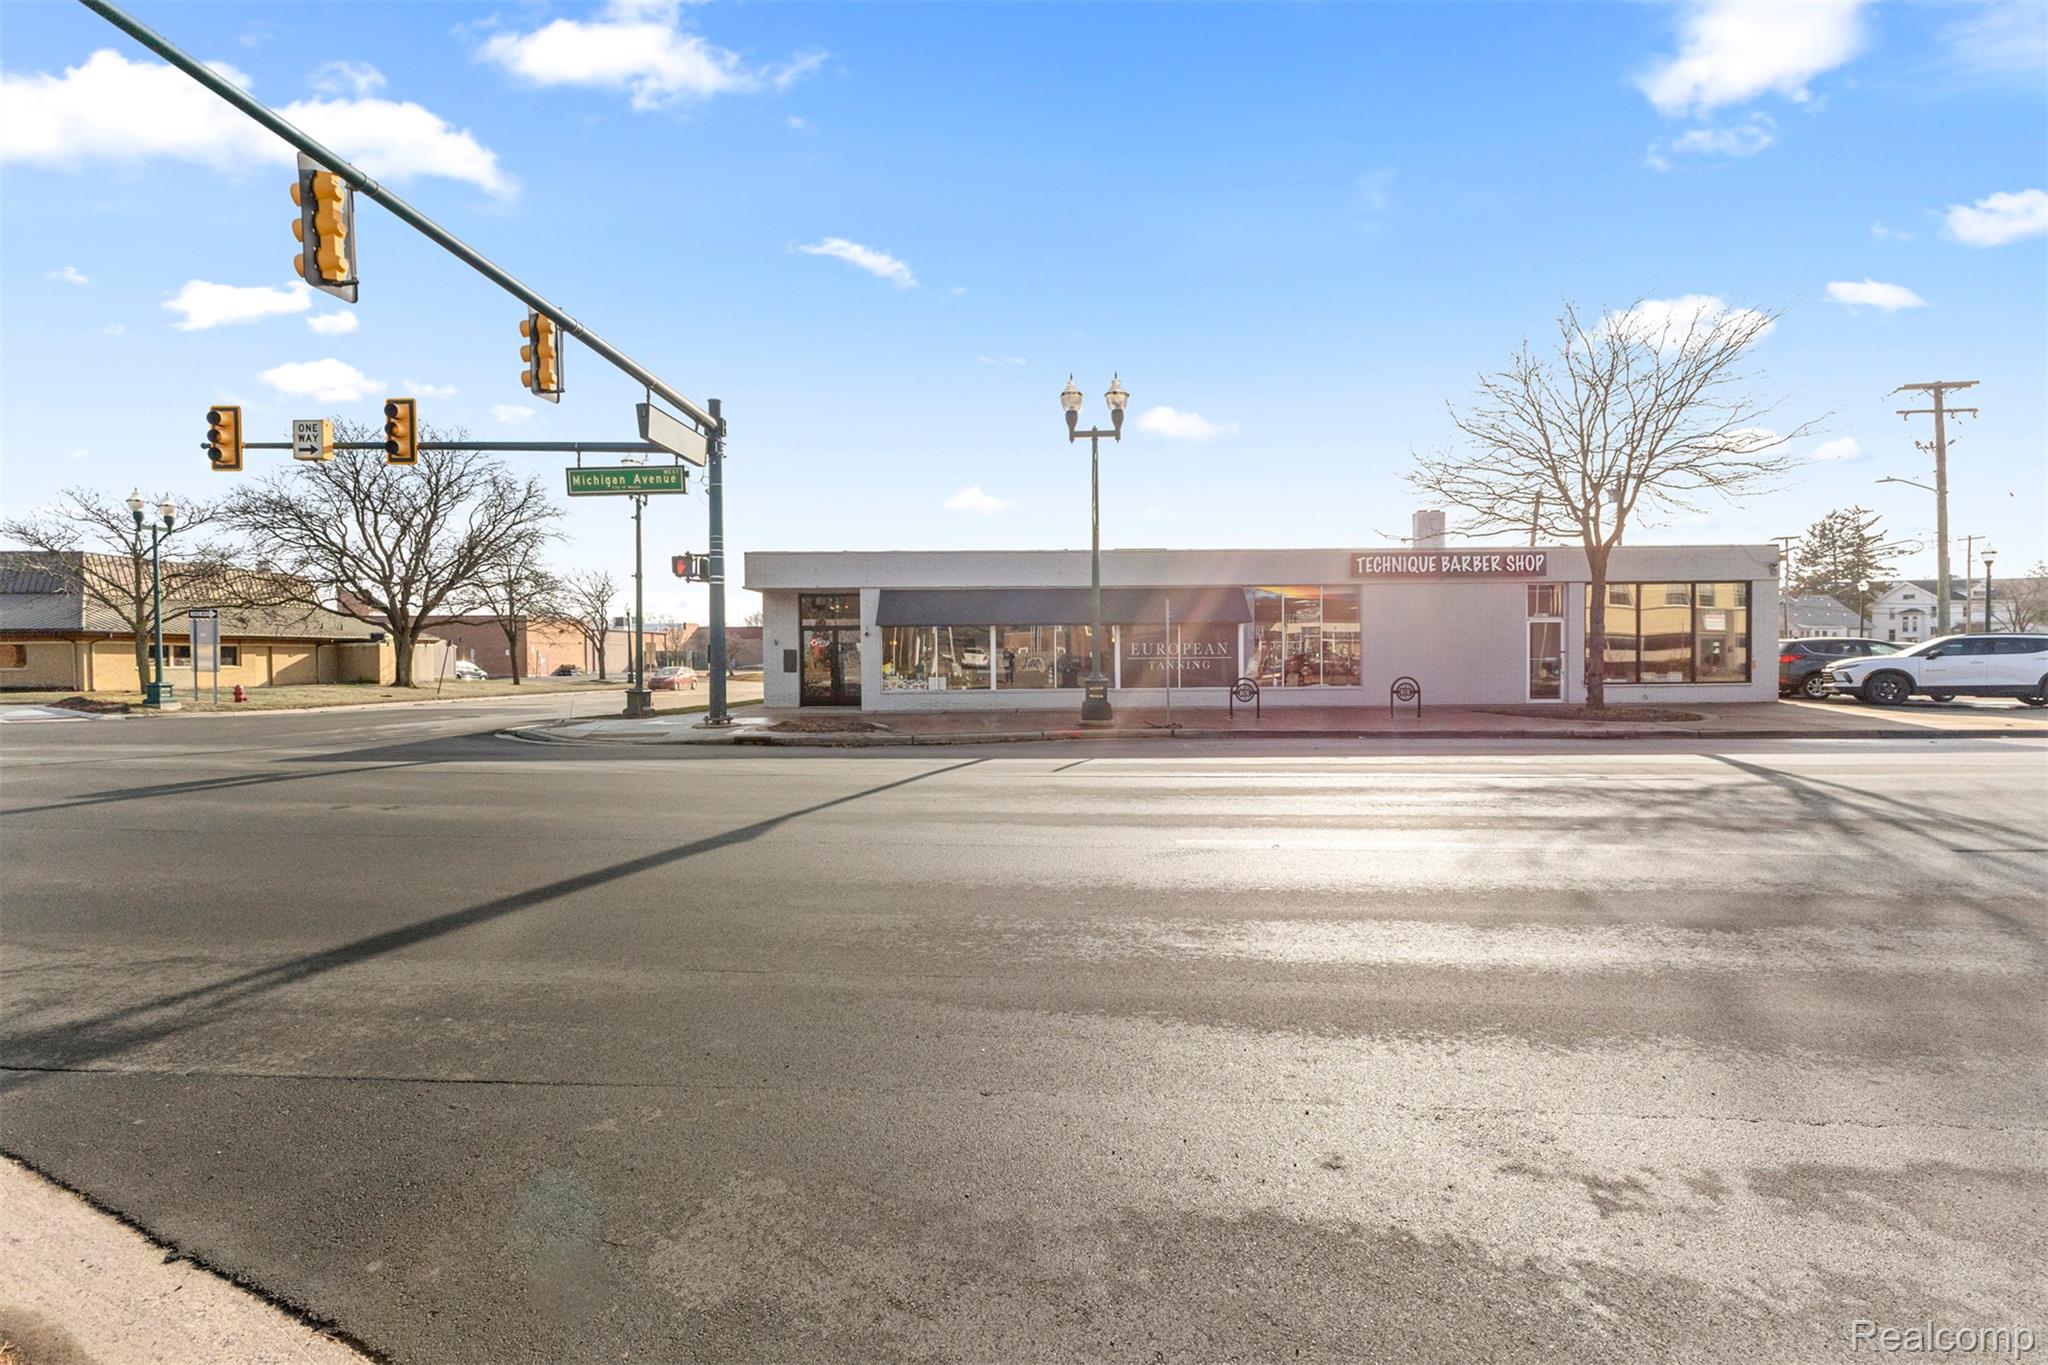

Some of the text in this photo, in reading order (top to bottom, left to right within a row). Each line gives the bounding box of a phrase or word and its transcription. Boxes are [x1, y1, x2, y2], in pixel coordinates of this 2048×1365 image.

[298, 423, 318, 432] ONE
[298, 434, 319, 442] WAY
[572, 474, 676, 487] Michigan Avenue
[1356, 554, 1545, 573] TECHNIQUE BARBER SHOP
[1130, 642, 1229, 656] EUROPEAN
[1148, 661, 1211, 670] TANNING
